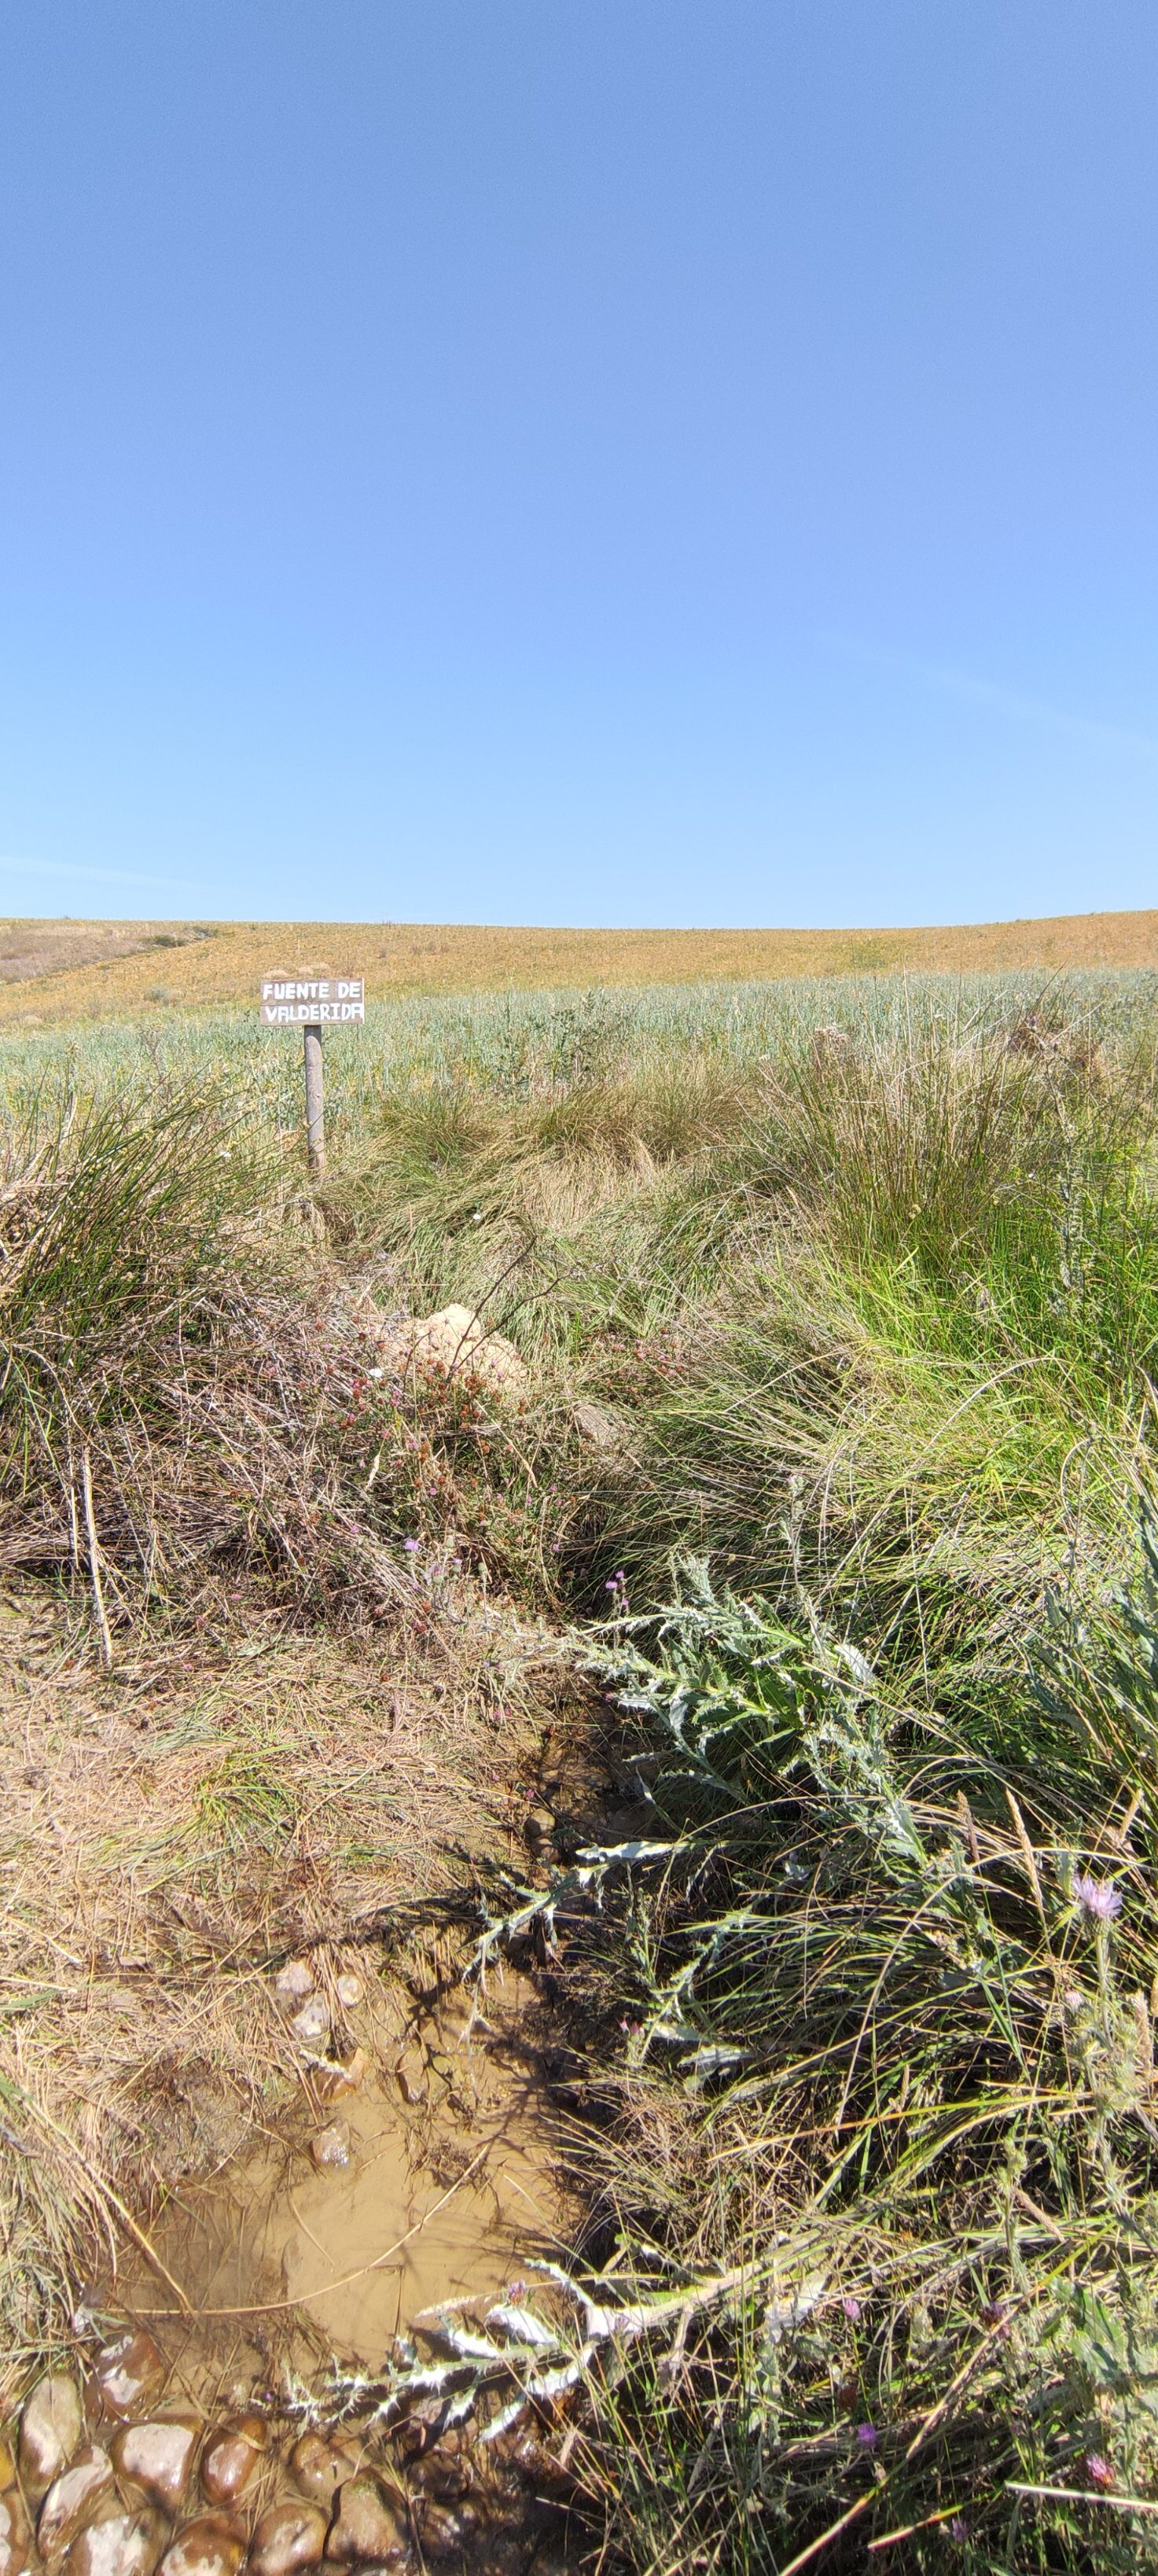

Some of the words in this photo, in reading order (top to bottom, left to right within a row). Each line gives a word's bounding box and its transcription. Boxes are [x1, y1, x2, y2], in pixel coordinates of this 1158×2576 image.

[263, 982, 330, 1000] FUENTE
[337, 981, 361, 999] DE
[264, 1003, 363, 1023] VALDERIDA
